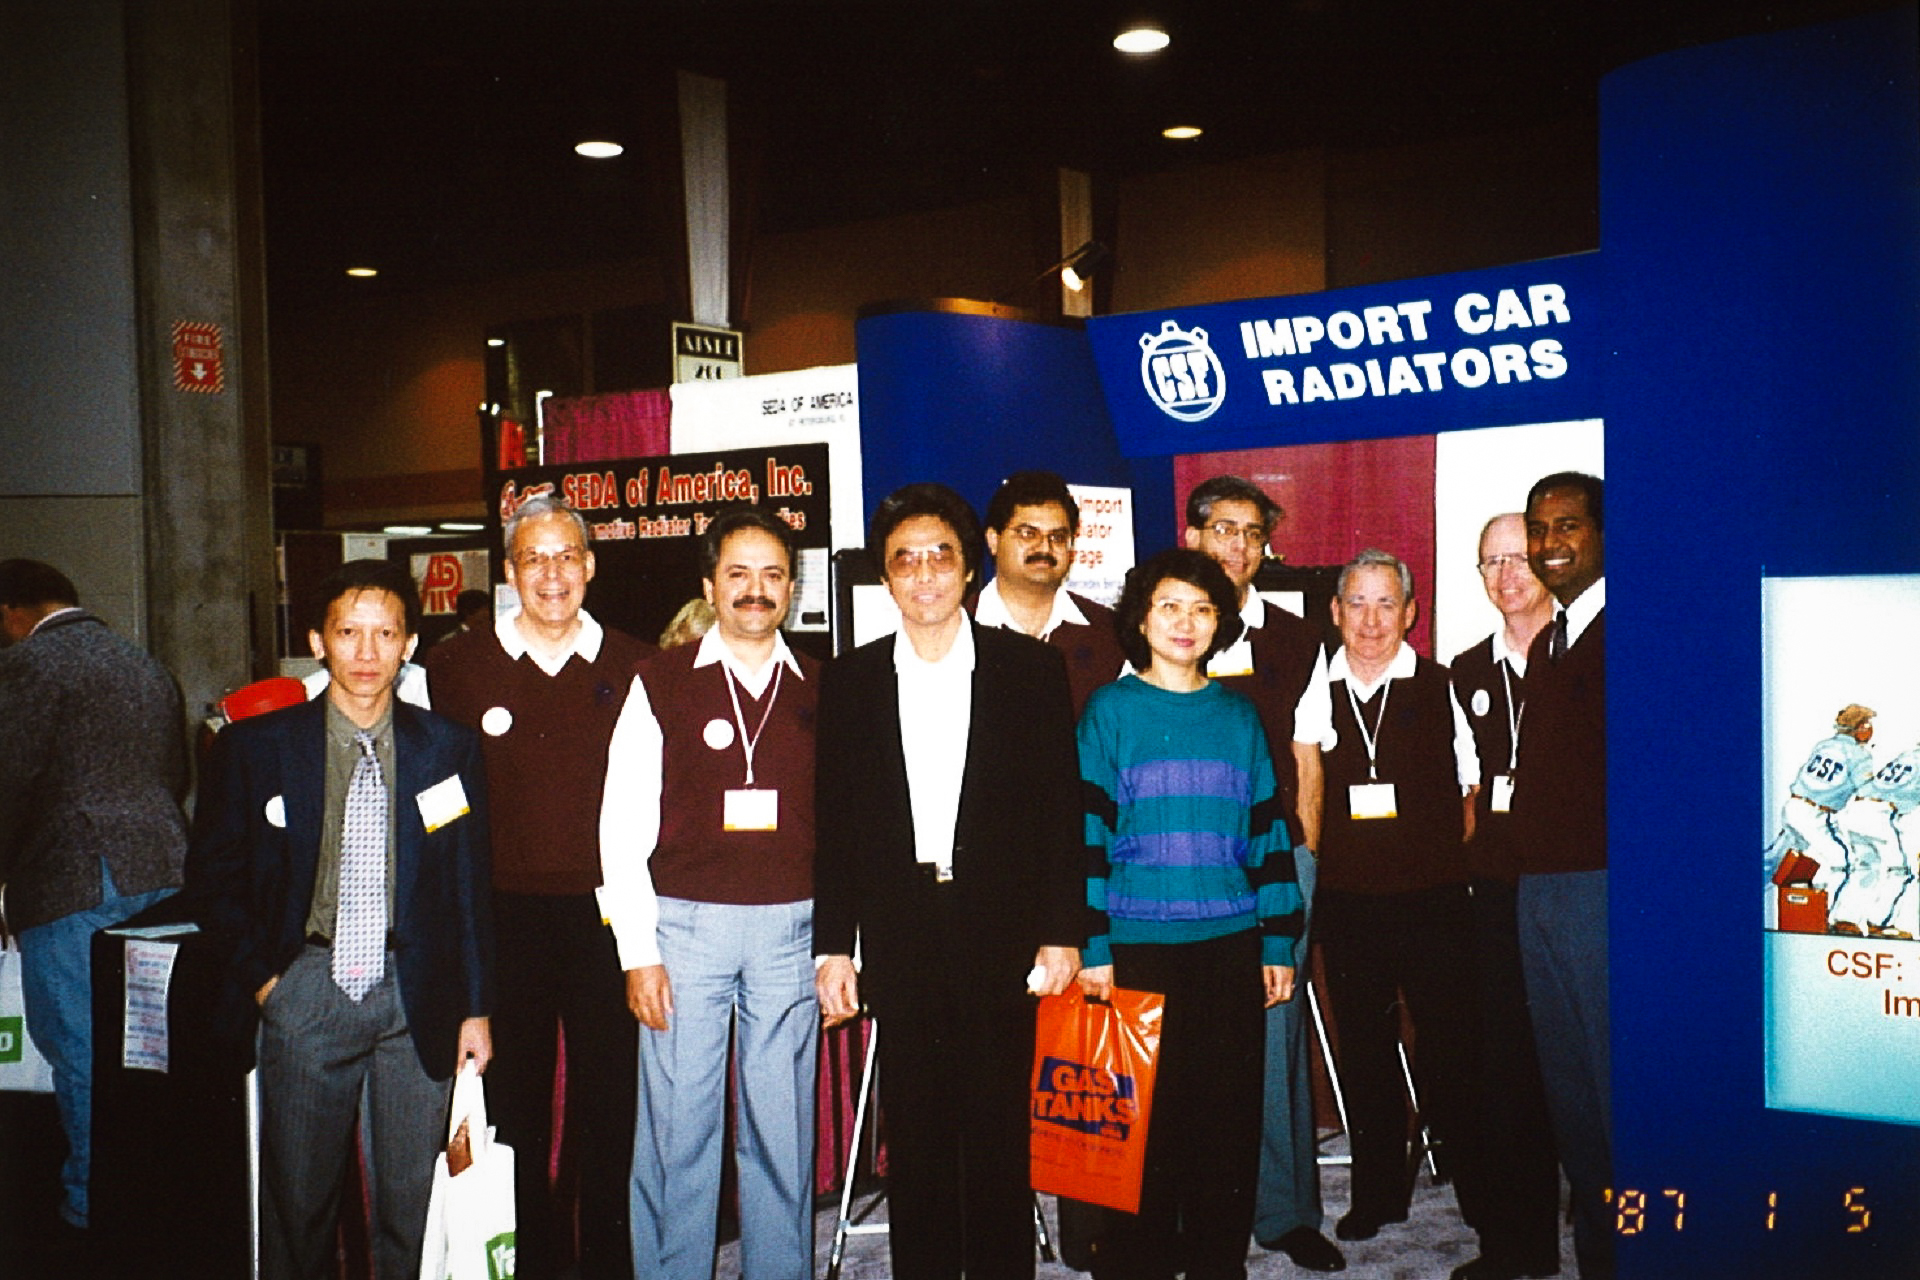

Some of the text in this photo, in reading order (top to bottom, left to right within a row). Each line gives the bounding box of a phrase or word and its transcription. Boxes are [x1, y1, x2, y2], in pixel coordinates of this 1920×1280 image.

[1240, 284, 1571, 359] IMPORT CAR
[682, 334, 733, 356] AISLE
[1152, 351, 1211, 403] CSF
[1262, 339, 1569, 405] RADIATORS
[761, 391, 854, 416] SEDA OF AMERICA
[562, 470, 619, 510] SEDA
[626, 466, 649, 508] of
[656, 461, 759, 504] America,
[767, 457, 812, 496] Inc.
[1079, 495, 1123, 517] Import
[638, 514, 691, 539] Radiator
[1807, 754, 1844, 782] CSF
[1876, 761, 1913, 783] CSF
[1827, 949, 1903, 981] CSF:
[1051, 1065, 1115, 1096] GAS
[1034, 1091, 1138, 1123] TANKS
